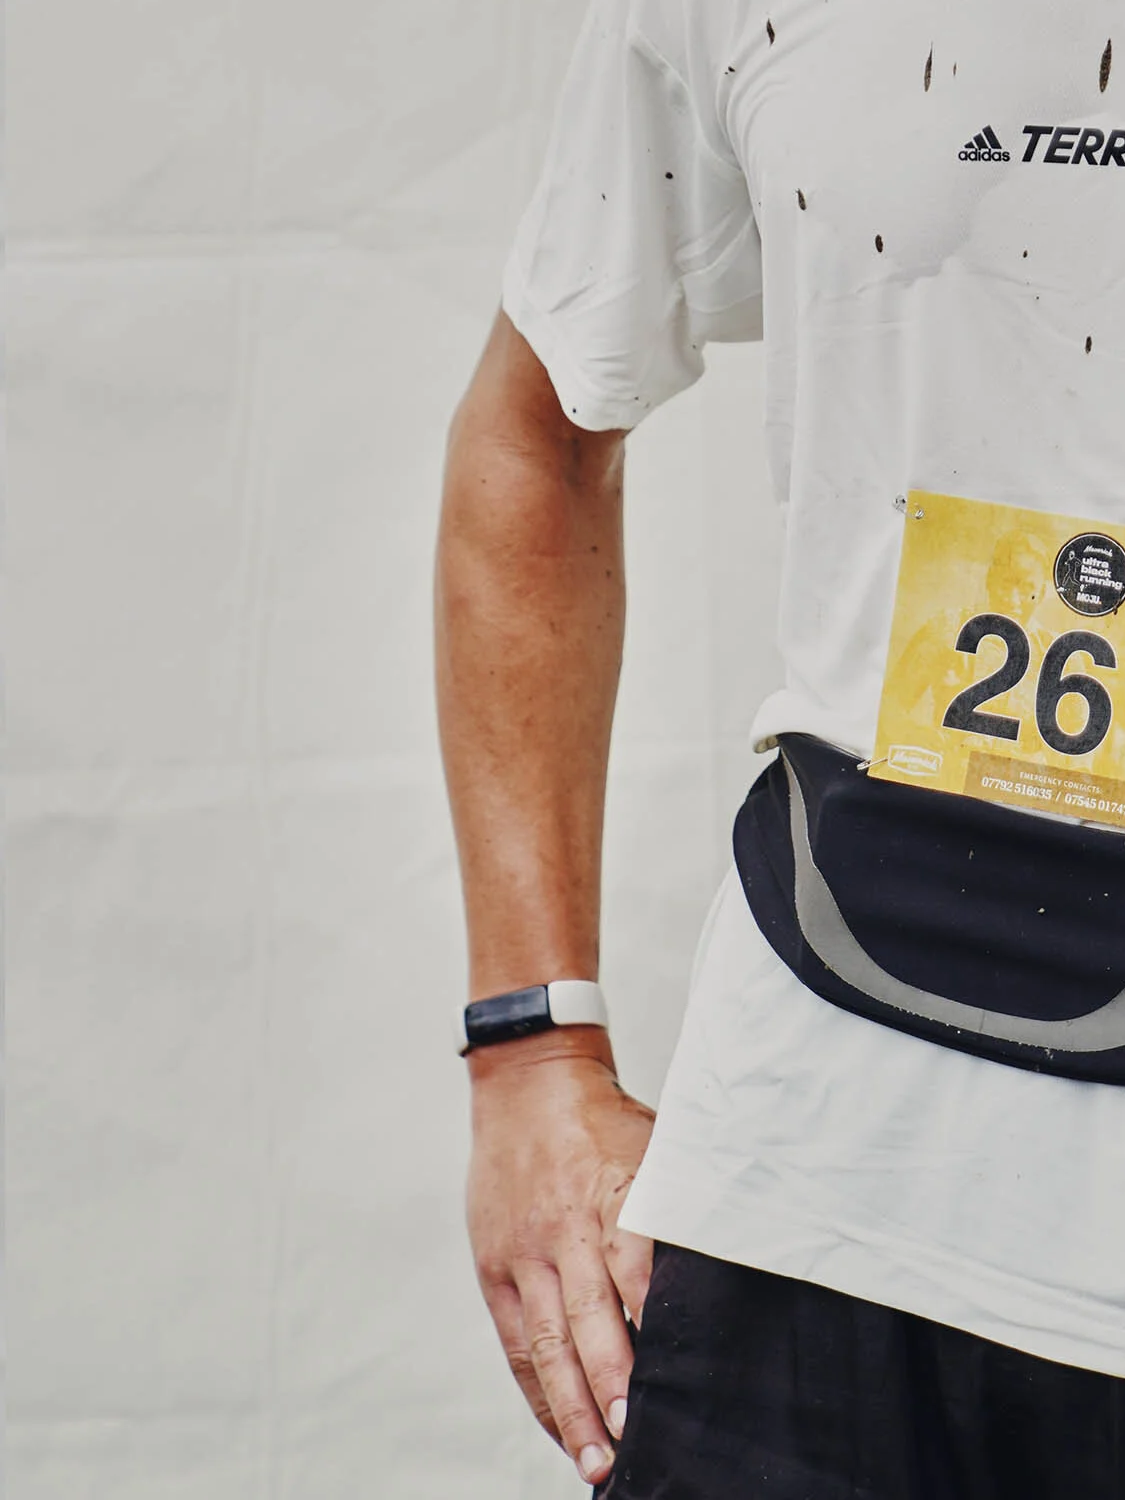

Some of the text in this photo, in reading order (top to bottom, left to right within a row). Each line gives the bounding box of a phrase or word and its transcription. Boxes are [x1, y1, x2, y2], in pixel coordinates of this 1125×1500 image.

[958, 148, 1011, 162] adidas
[1082, 557, 1110, 569] ultra
[1080, 565, 1112, 578] black
[1019, 771, 1062, 786] EMERGENCY
[981, 776, 1013, 792] 07792
[1014, 782, 1053, 800] 516035
